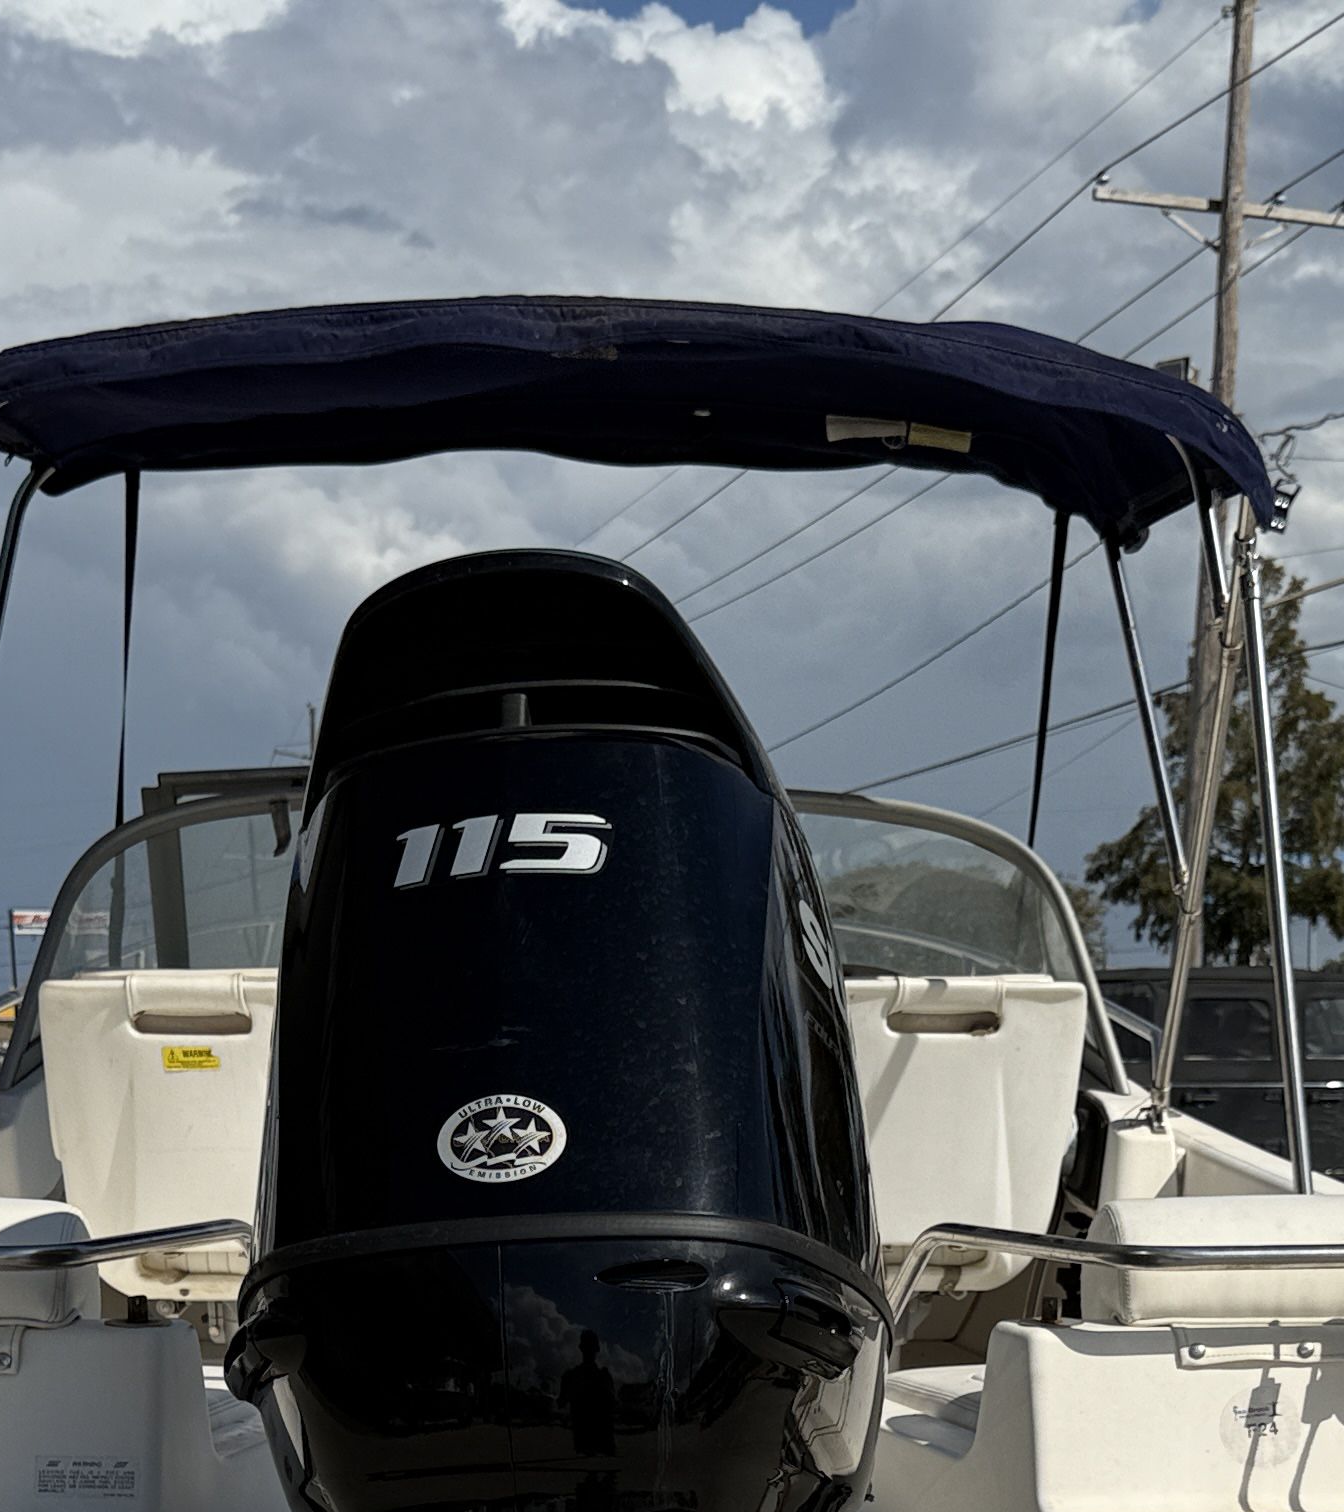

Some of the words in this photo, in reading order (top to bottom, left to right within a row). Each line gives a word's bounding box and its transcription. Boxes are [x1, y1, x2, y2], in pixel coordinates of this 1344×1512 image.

[393, 813, 613, 890] 115
[458, 1096, 503, 1119] ULTRA
[514, 1096, 546, 1114] LOW
[468, 1164, 537, 1179] EMISSION
